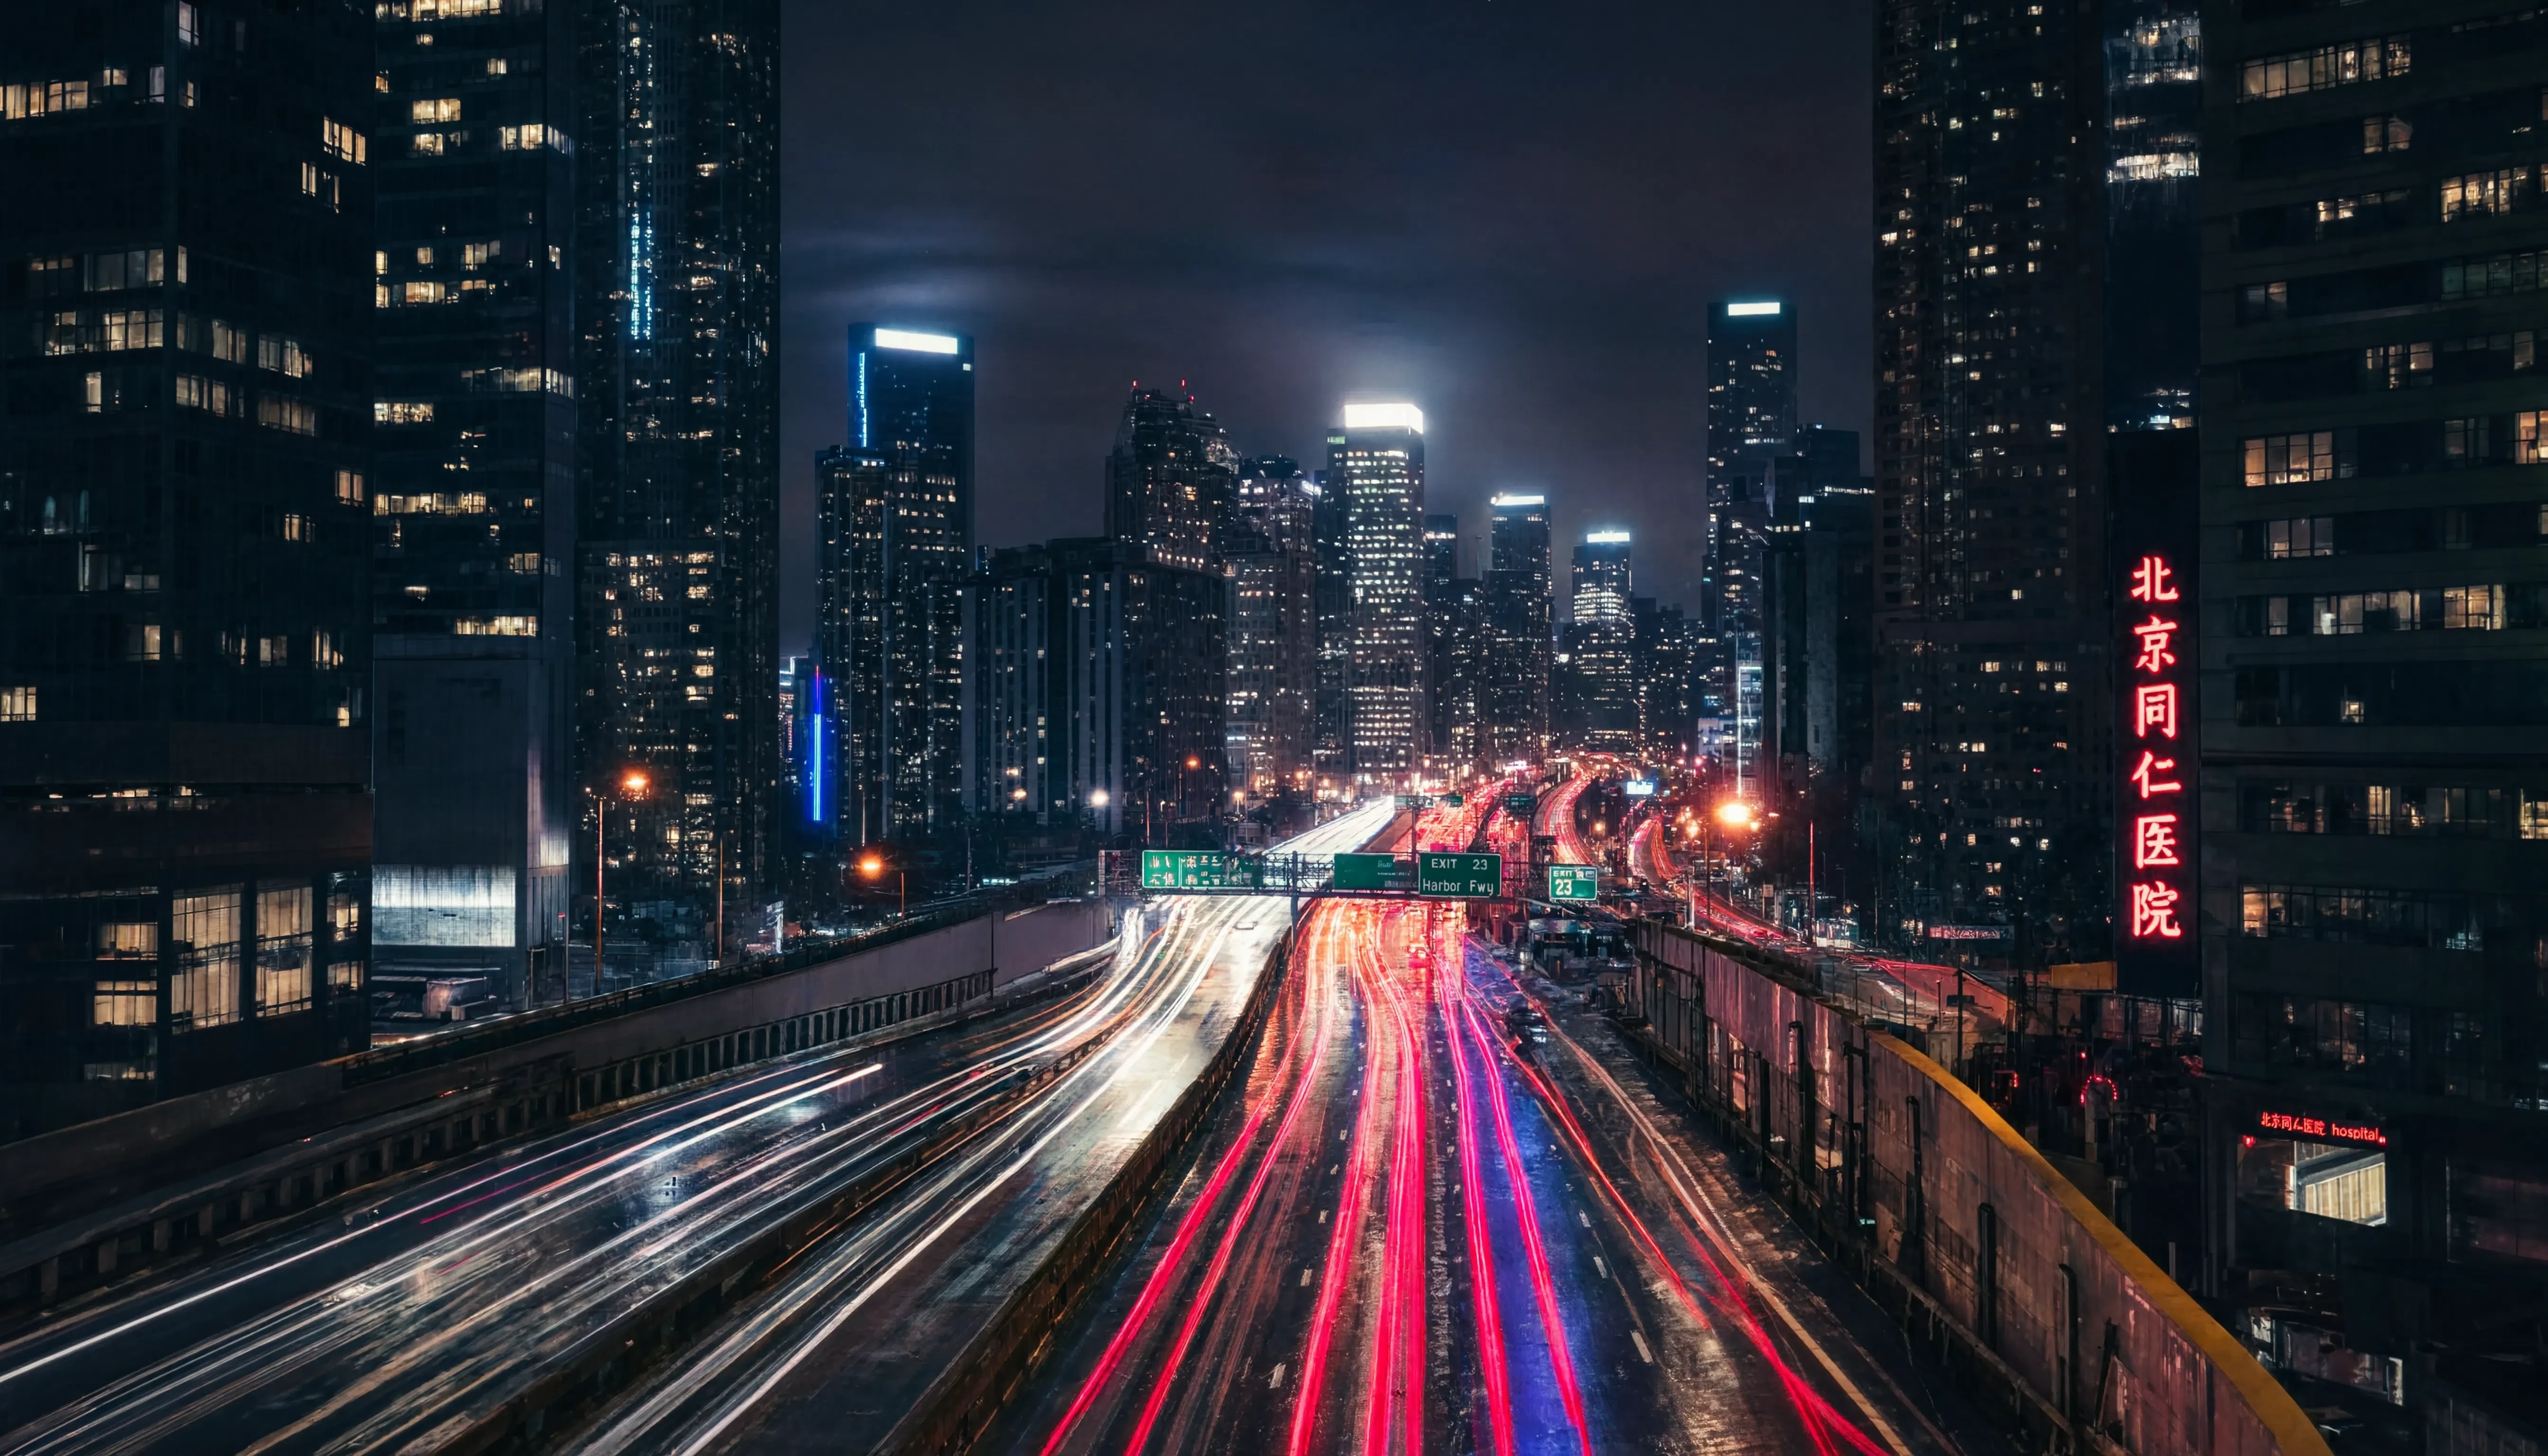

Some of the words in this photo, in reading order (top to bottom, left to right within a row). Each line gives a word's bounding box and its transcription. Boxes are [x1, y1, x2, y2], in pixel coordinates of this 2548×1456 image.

[2130, 555, 2182, 938] 北京同仁医院
[1431, 858, 1457, 869] EXIT
[1473, 859, 1488, 870] 23
[1423, 878, 1461, 892] Harbor
[1470, 880, 1493, 896] Fwy
[1555, 879, 1572, 896] 23
[2332, 1123, 2379, 1140] hospital
